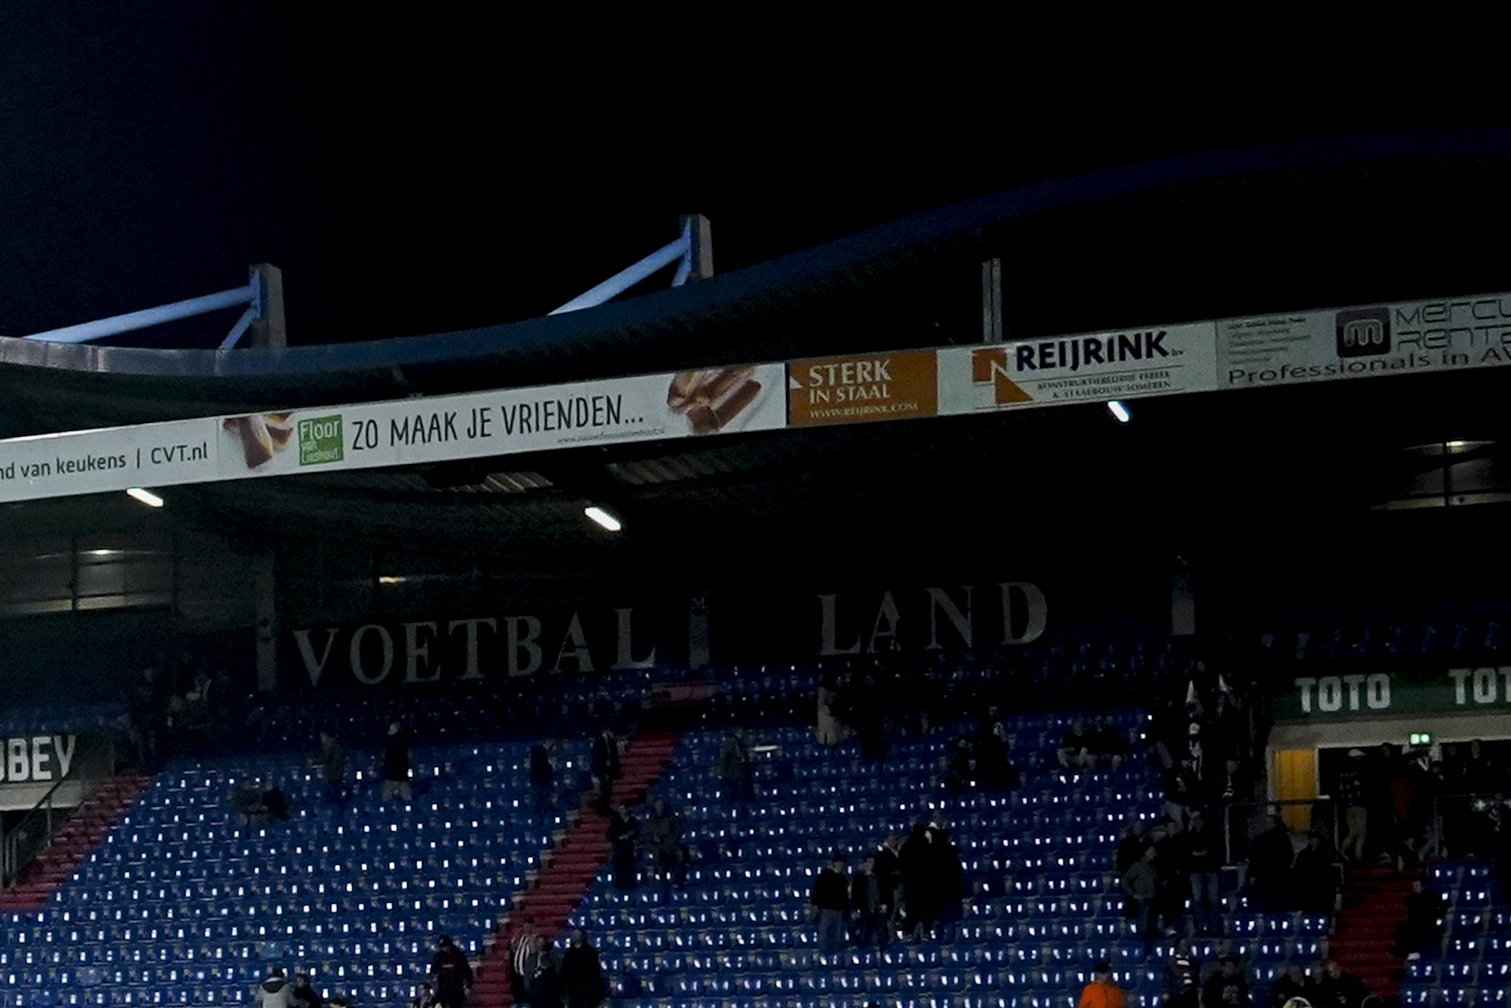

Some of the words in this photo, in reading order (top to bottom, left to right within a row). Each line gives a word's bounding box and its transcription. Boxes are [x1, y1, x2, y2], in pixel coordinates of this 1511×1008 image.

[1017, 331, 1170, 371] REIJRINK
[1229, 352, 1431, 384] Professionals
[1441, 352, 1469, 366] in
[809, 360, 893, 387] STERK
[809, 389, 830, 404] IN
[836, 384, 890, 401] STAAL
[300, 420, 340, 441] Floor
[352, 419, 379, 450] ZO
[390, 411, 458, 447] MAAK
[467, 407, 492, 438] JE
[501, 394, 643, 436] VRIENDEN...
[19, 464, 51, 478] van
[56, 453, 127, 475] keukens
[150, 442, 208, 465] CVT.nl
[292, 606, 657, 688] VOETBAL
[815, 580, 1049, 657] LAND
[1295, 673, 1392, 713] TOTO
